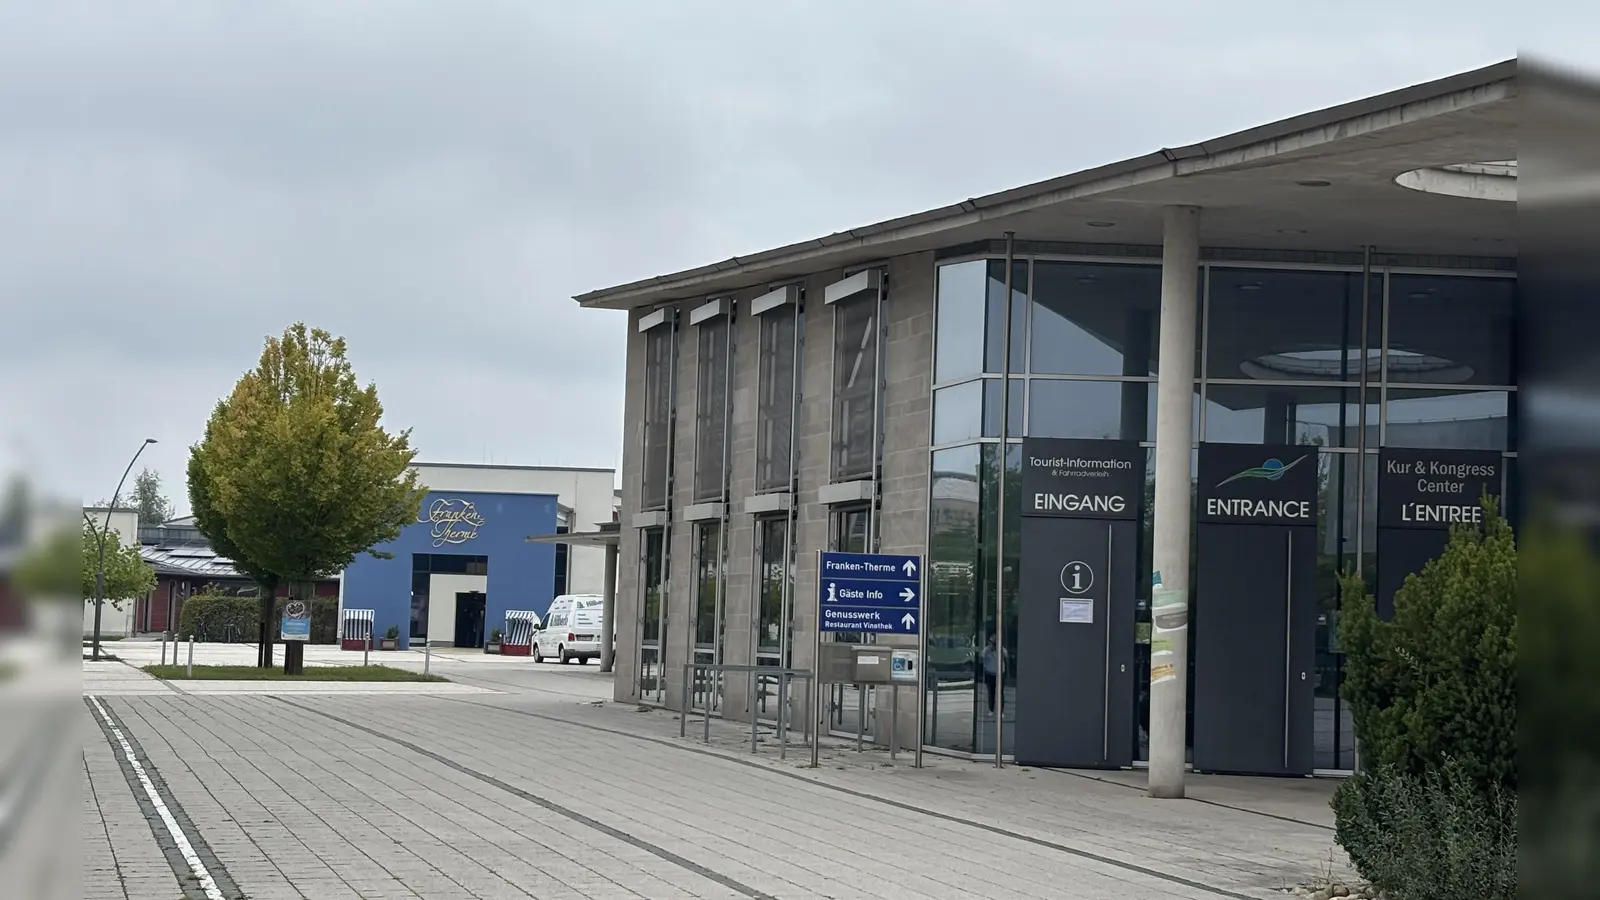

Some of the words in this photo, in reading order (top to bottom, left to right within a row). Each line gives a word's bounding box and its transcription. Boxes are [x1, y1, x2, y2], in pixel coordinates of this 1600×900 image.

[1029, 456, 1132, 469] Tourist-Information
[1387, 460, 1411, 474] Kur
[1414, 461, 1426, 475] &
[1430, 461, 1495, 477] Kongress
[1058, 469, 1109, 477] Fahrradverleih
[1417, 478, 1465, 493] Center
[1034, 493, 1125, 512] EINGANG
[1207, 499, 1309, 518] ENTRANCE
[430, 519, 479, 548] Therme
[826, 561, 896, 572] Franken-Therme
[839, 588, 864, 599] Gäste
[866, 590, 883, 599] Info
[825, 610, 880, 620] Genusswerk
[824, 621, 862, 629] Restaurant
[863, 622, 893, 630] Vinothek
